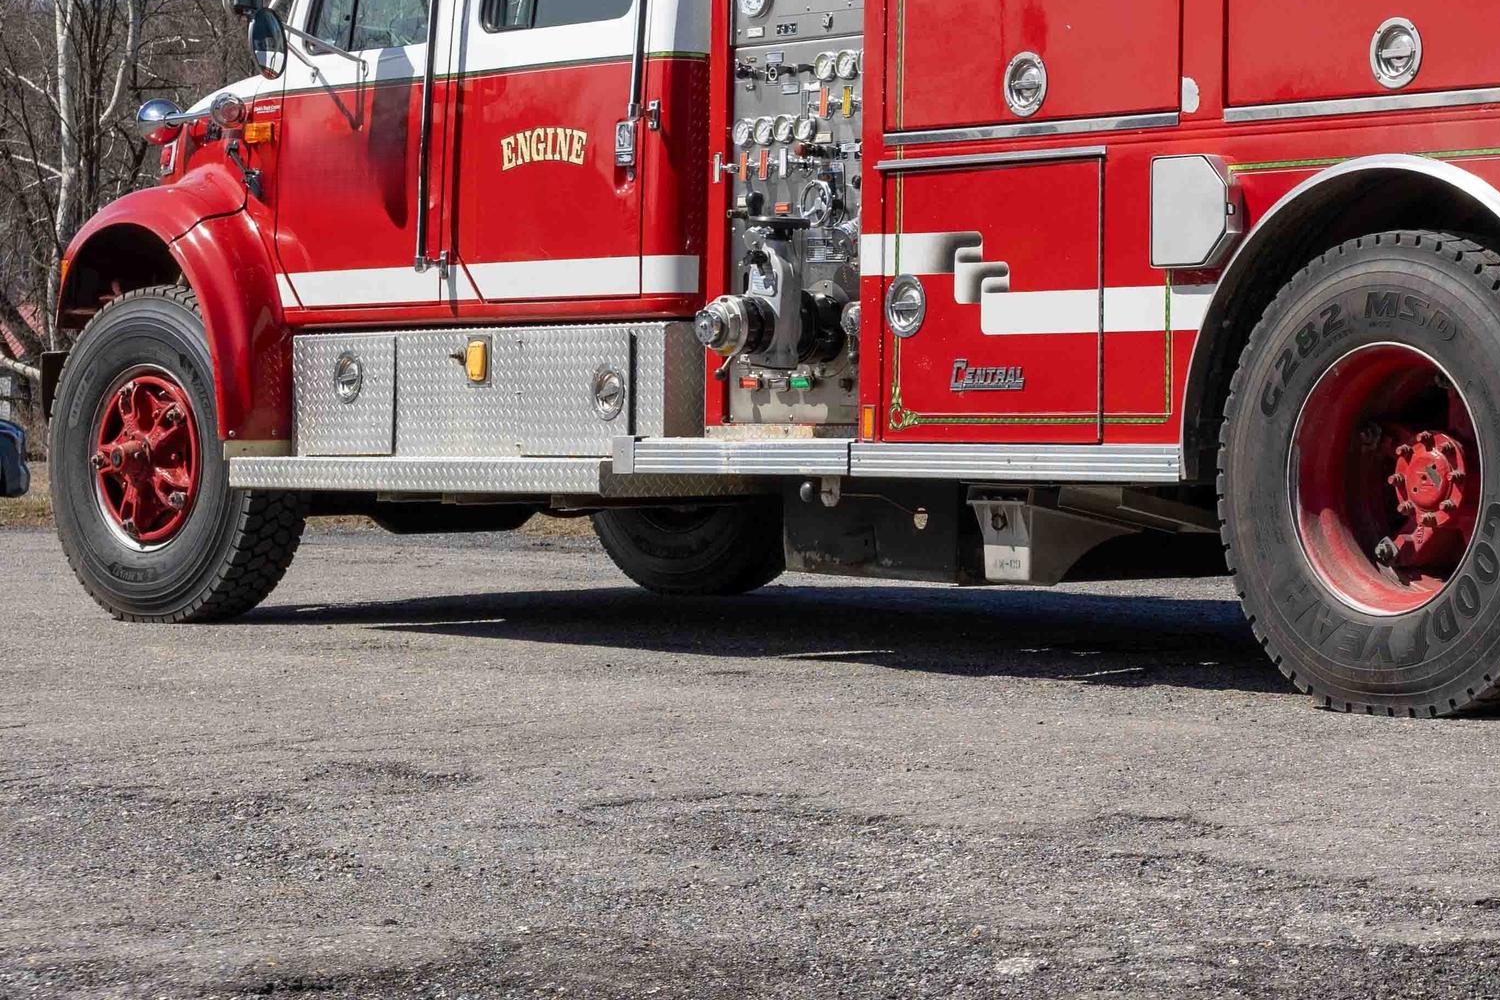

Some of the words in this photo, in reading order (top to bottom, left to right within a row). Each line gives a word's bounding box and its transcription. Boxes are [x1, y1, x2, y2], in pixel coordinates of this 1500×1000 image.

[500, 127, 588, 171] ENGINE
[950, 359, 1025, 391] CENTRAL
[1260, 301, 1347, 418] G282
[1364, 291, 1458, 342] MSD
